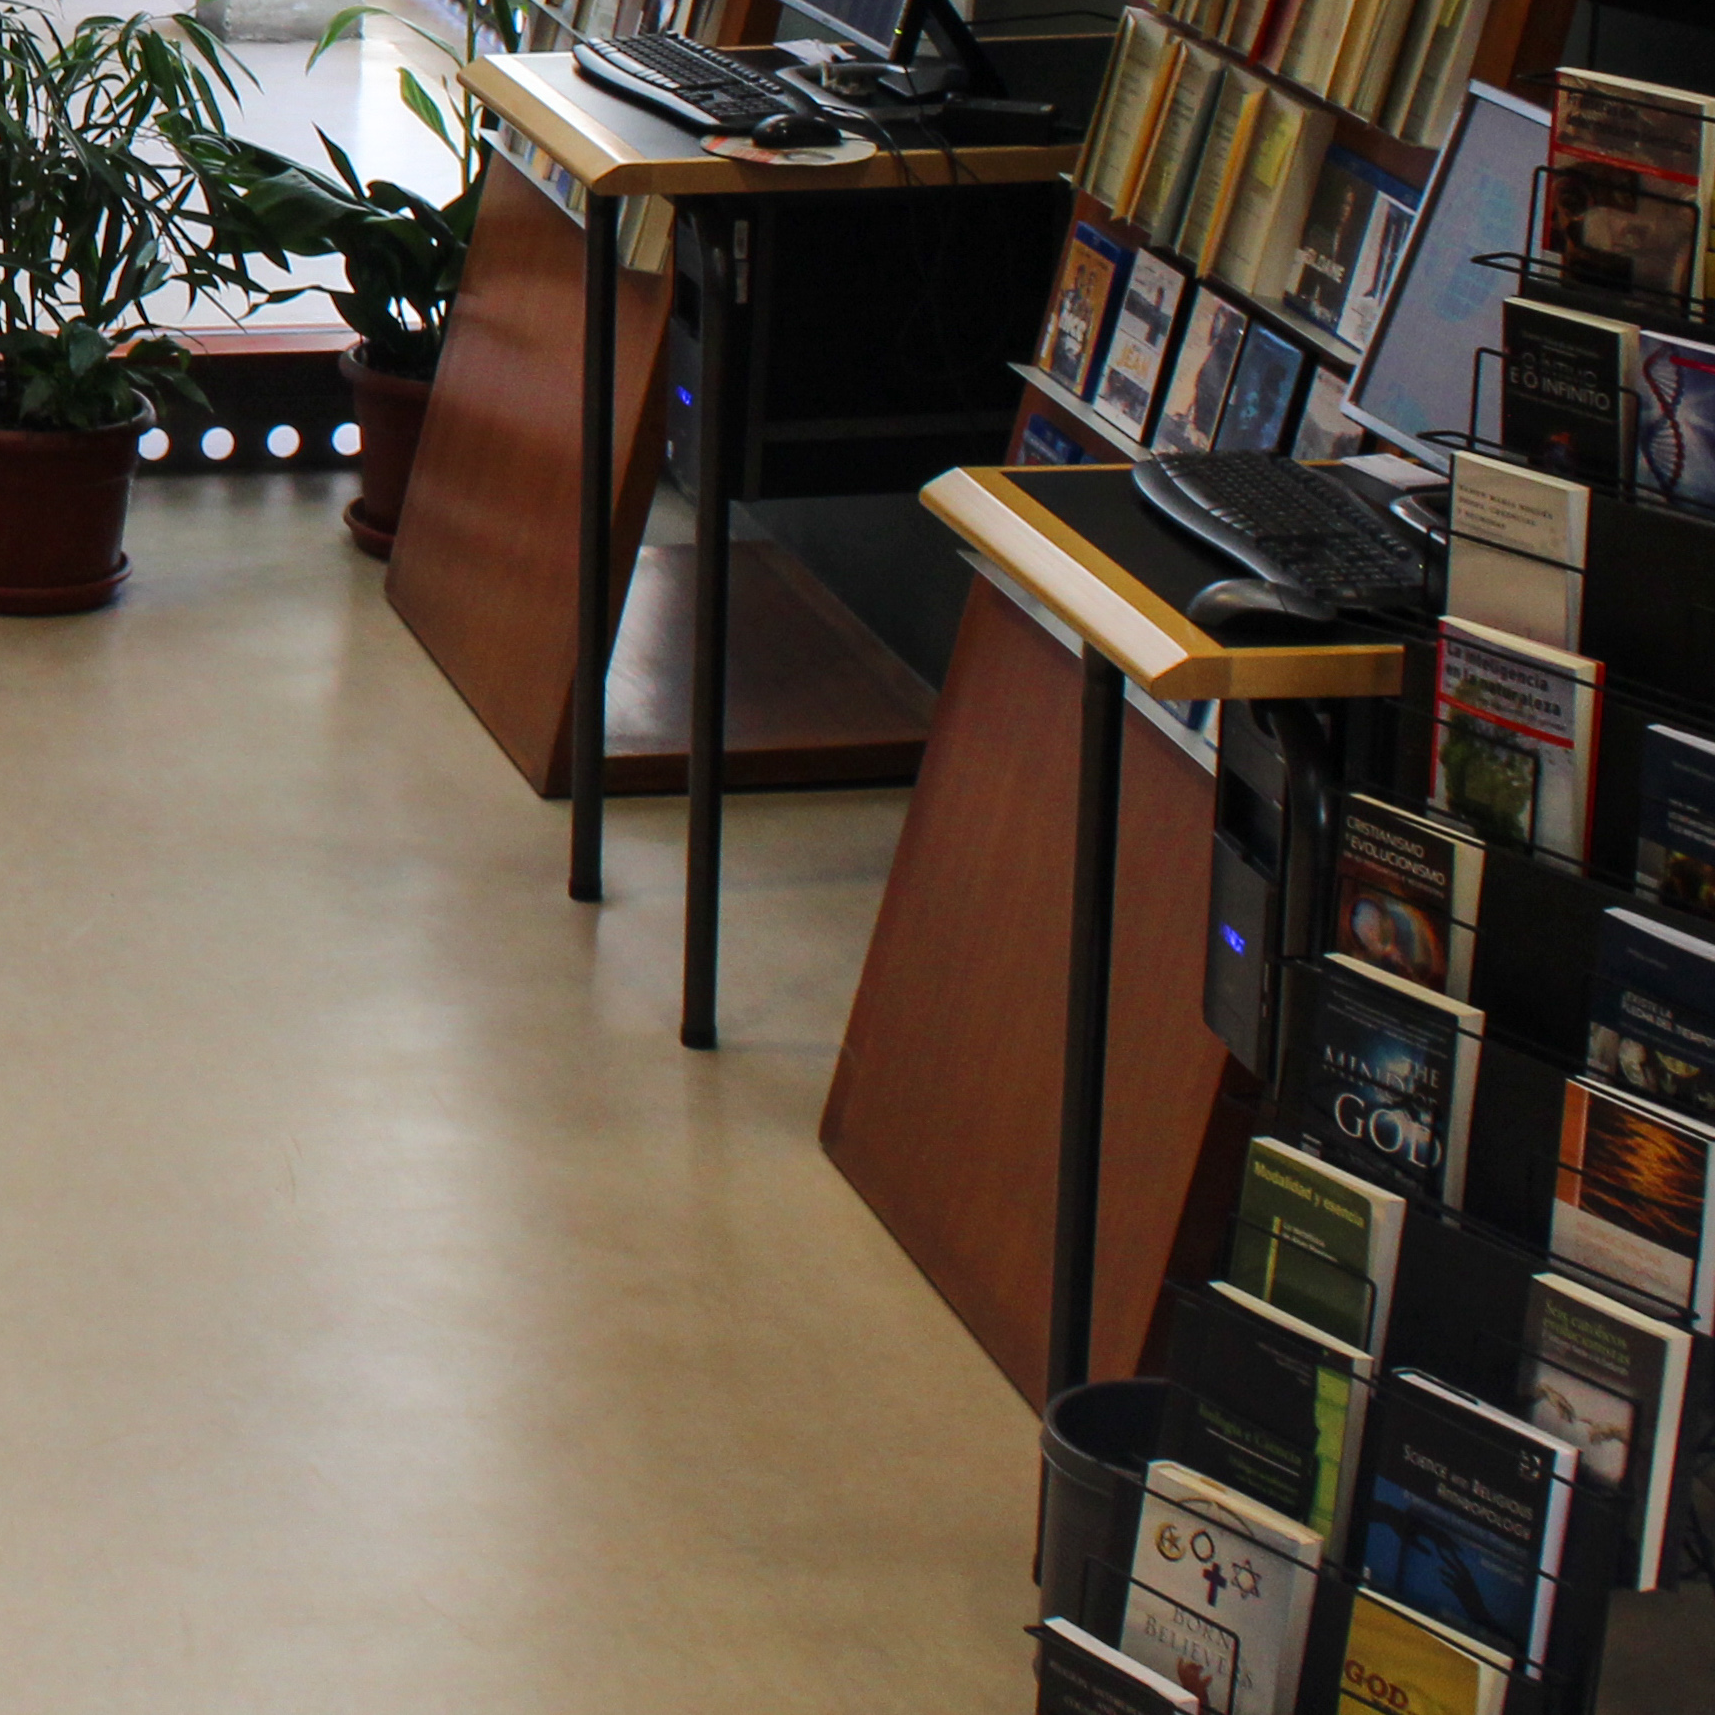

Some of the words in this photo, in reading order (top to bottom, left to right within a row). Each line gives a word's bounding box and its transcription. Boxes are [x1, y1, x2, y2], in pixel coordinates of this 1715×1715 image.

[1346, 814, 1426, 859] CRISTIANISMO
[1350, 834, 1446, 887] EVOLUCIONISMO
[1334, 1092, 1442, 1169] GOD
[1344, 1658, 1410, 1710] GOD
